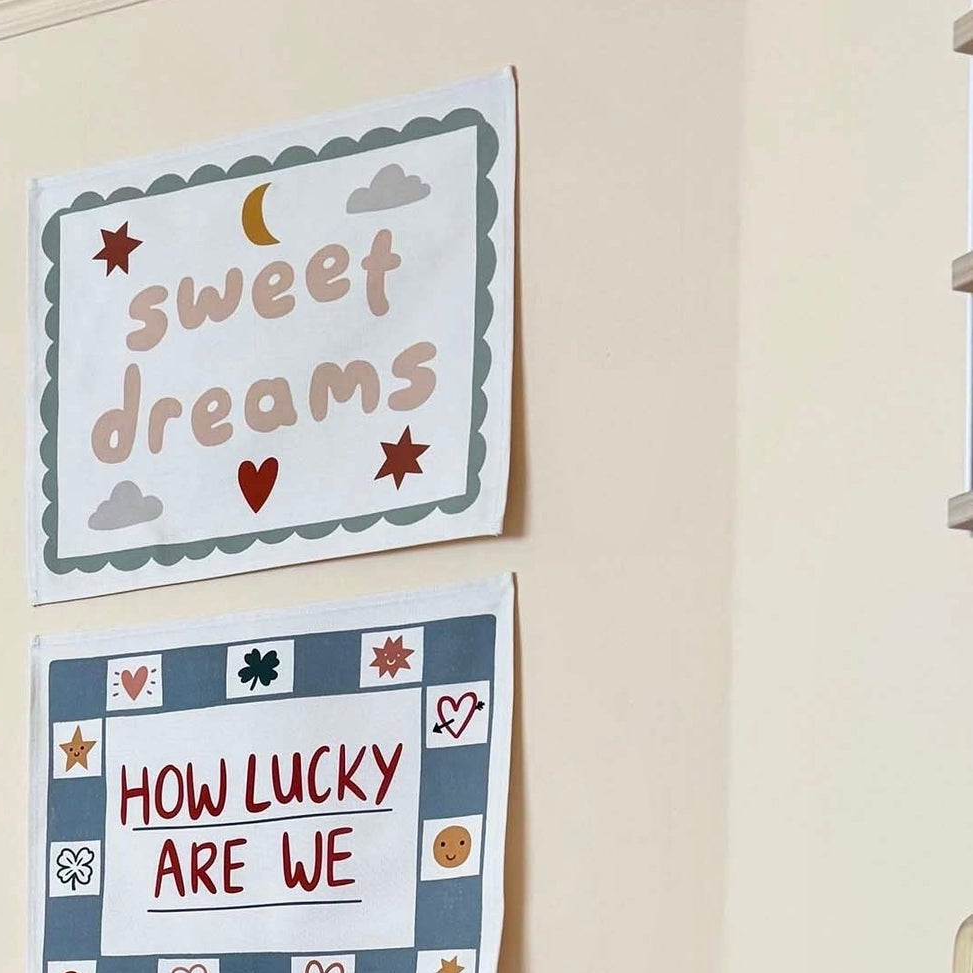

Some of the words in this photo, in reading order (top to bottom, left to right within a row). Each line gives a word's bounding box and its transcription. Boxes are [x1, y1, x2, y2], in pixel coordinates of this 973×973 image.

[125, 228, 402, 352] sweet
[91, 341, 437, 464] dreams
[121, 758, 226, 826] HOW
[244, 743, 404, 814] LUCKY
[154, 838, 247, 898] ARE
[282, 827, 356, 892] WE
